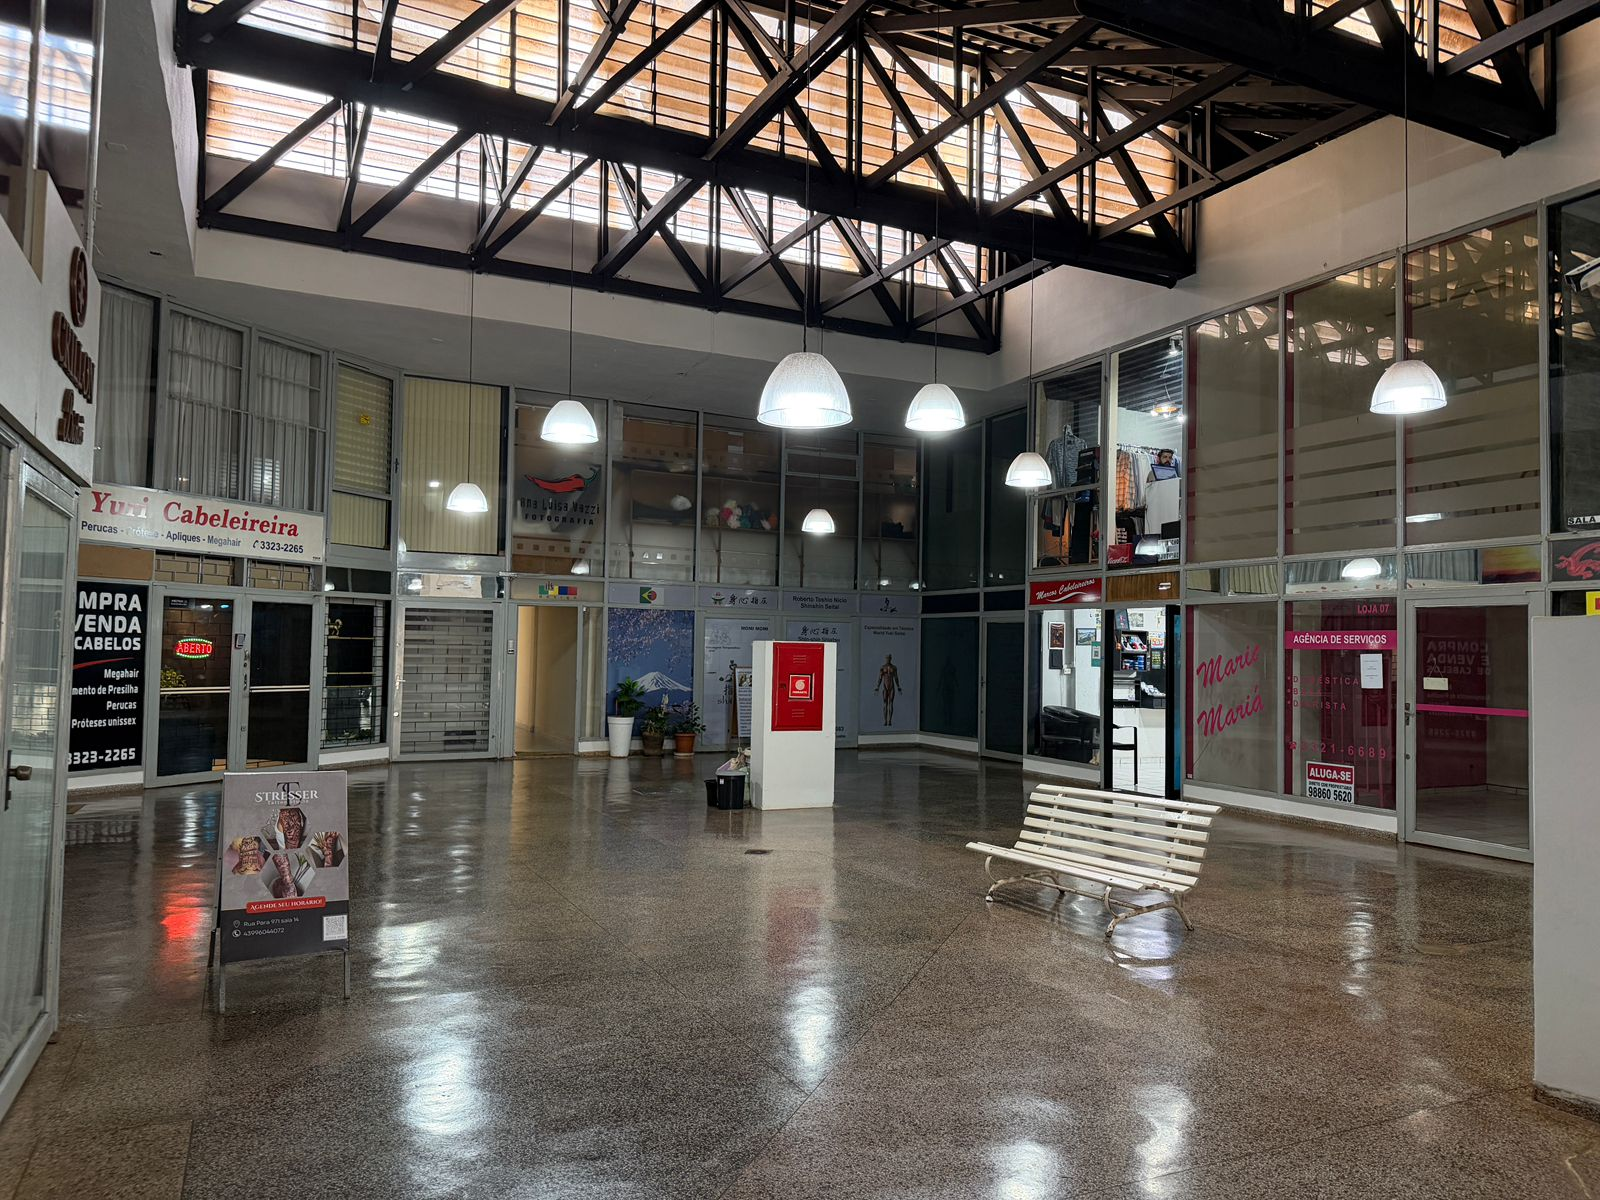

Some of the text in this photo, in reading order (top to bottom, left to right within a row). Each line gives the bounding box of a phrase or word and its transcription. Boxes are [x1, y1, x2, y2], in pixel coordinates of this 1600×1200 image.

[92, 491, 299, 537] Yuri Cabeleireira
[1568, 516, 1596, 525] SALA
[81, 521, 118, 534] Perucas
[166, 531, 201, 543] Apliques
[207, 535, 241, 547] Megahair
[260, 541, 304, 554] 3323-2265
[1035, 578, 1096, 600] Marcos Cabeleireiros
[79, 591, 142, 612] MPRA
[1357, 604, 1390, 614] LOJA 07
[74, 636, 141, 651] CABELOS
[1293, 632, 1387, 645] AGÊNCIA DE SERVIÇOS
[176, 642, 213, 654] ABERTO
[104, 668, 140, 680] Megahair
[1293, 676, 1359, 685] DÉSTICA
[97, 685, 107, 695] de
[107, 684, 139, 695] Presilha
[106, 700, 137, 711] Perucas
[71, 716, 137, 729] Próteses unissex
[1309, 768, 1352, 781] ALUGA-SE
[255, 790, 319, 803] STRESSER
[1308, 786, 1352, 802] 98860 5620
[250, 903, 276, 911] AGENDE
